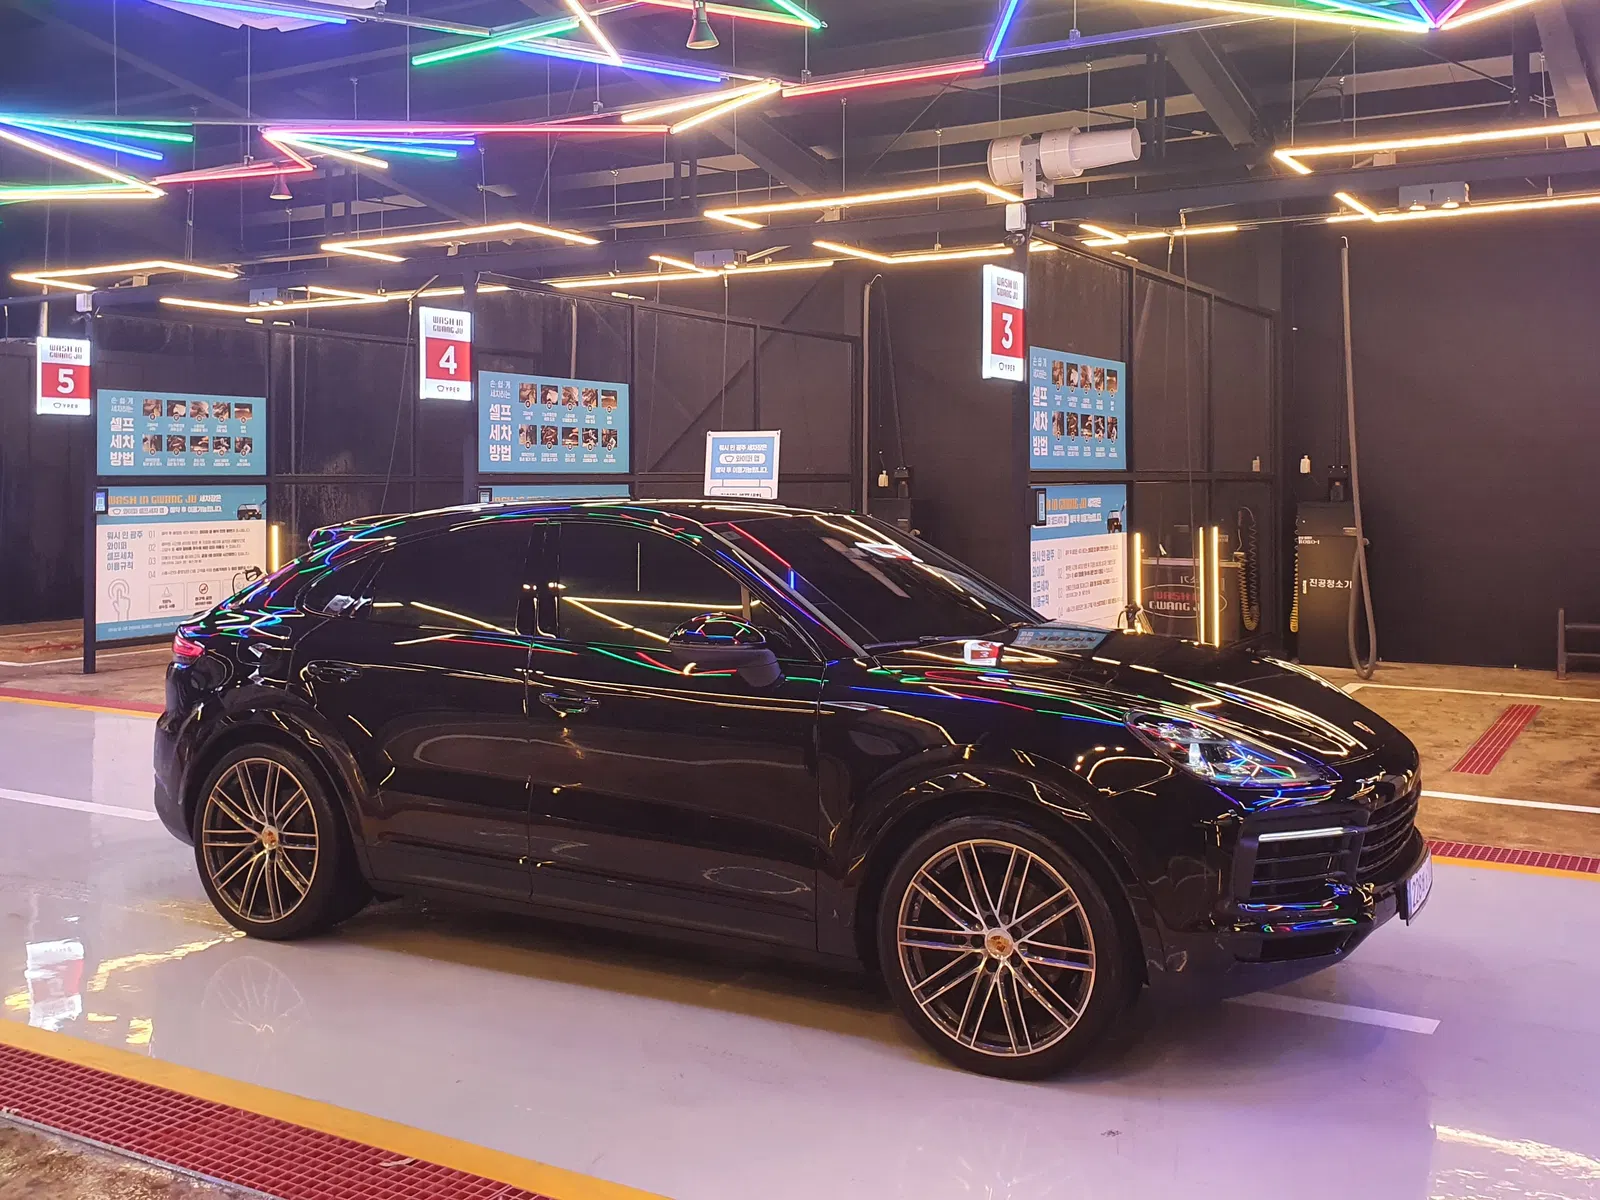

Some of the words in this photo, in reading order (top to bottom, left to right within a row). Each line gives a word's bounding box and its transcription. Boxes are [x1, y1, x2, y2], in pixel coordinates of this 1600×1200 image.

[433, 316, 455, 325] WASH
[433, 325, 455, 333] GWANG
[1001, 312, 1013, 350] 3
[50, 344, 73, 352] WASH
[439, 345, 458, 375] 4
[1004, 364, 1015, 372] YPER
[56, 368, 74, 394] 5
[1033, 385, 1048, 407] 셀프
[489, 403, 512, 421] 셀프
[110, 417, 135, 432] 셀프
[1033, 411, 1048, 431] 세차
[489, 424, 512, 441] 세차
[110, 435, 135, 449] 세차
[1033, 436, 1048, 456] 방법
[489, 444, 512, 462] 방법
[110, 452, 135, 466] 방법
[107, 531, 121, 540] 워시
[122, 531, 129, 539] 인
[130, 530, 143, 539] 광주
[148, 530, 155, 538] 01
[106, 541, 127, 550] 와이퍼
[148, 544, 156, 552] 02
[107, 551, 133, 561] 셀프세차
[148, 557, 156, 565] 03
[1309, 578, 1352, 589] 진공청소기
[1154, 591, 1191, 601] WASH
[1149, 600, 1190, 611] GWANG
